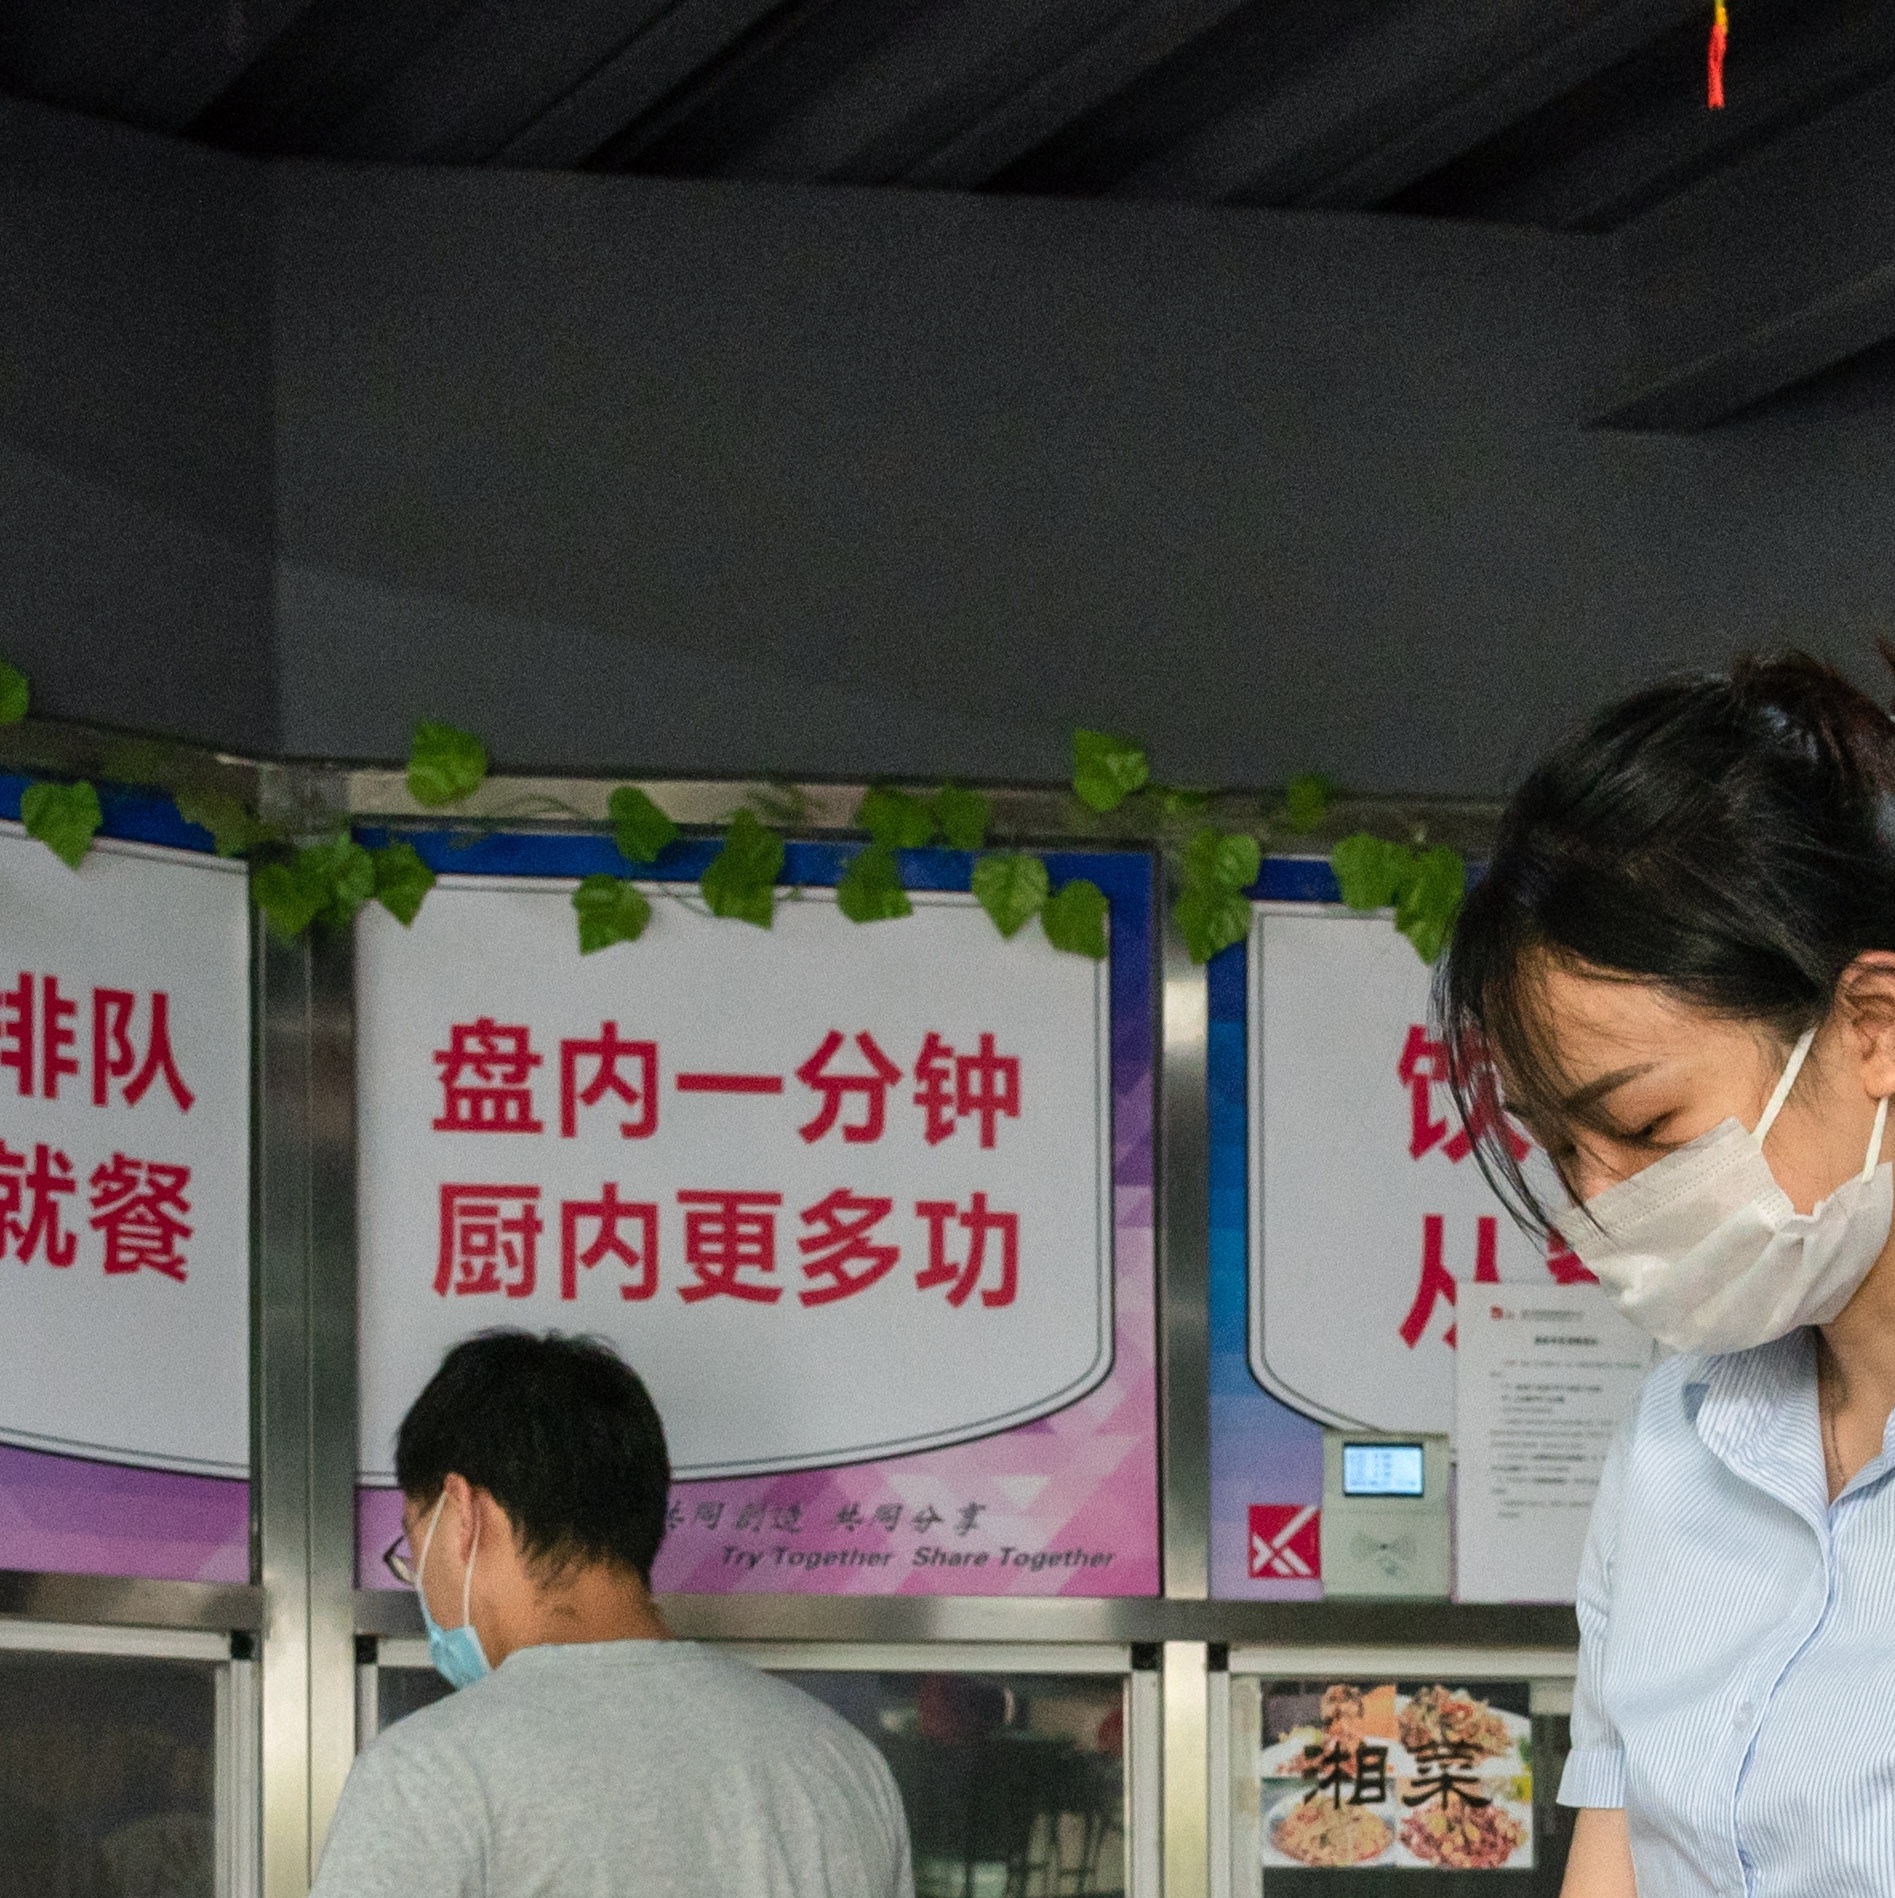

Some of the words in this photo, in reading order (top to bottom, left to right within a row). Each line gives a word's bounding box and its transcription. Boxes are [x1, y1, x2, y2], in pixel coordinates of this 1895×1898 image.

[431, 1016, 1021, 1151] 盘内一分钟
[432, 1181, 1019, 1310] 厨内更多功
[722, 1545, 764, 1571] Try
[772, 1545, 894, 1571] Together
[911, 1546, 989, 1568] Share
[998, 1546, 1116, 1571] Together
[1302, 1737, 1494, 1812] 湘菜
